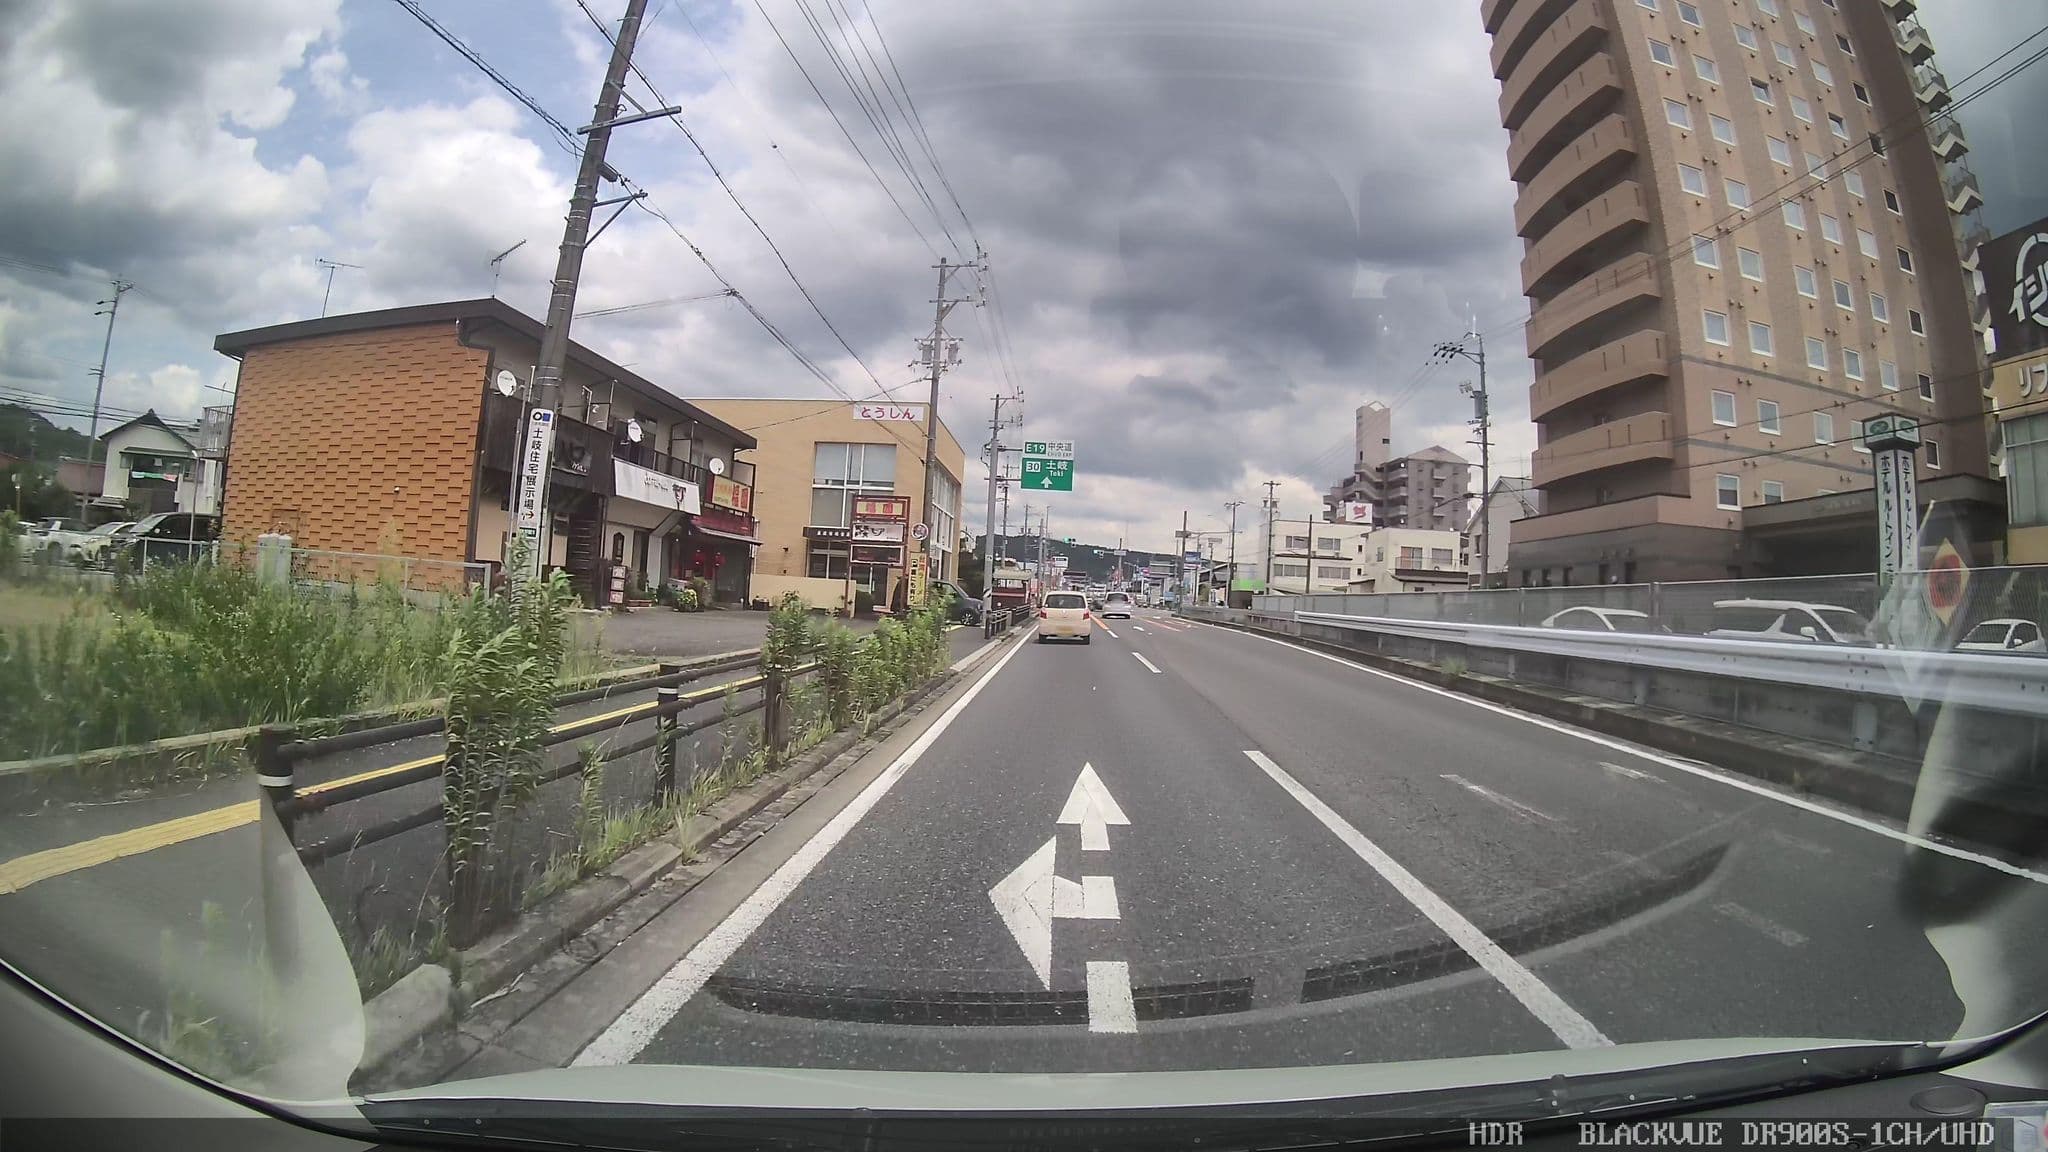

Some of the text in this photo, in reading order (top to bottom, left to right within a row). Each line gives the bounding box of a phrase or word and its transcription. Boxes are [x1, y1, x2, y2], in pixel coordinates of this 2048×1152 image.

[861, 407, 915, 420] とうしん
[1026, 444, 1046, 453] E19
[1048, 442, 1072, 452] 中央道
[524, 428, 543, 510] 土岐住宅展示場
[1027, 462, 1040, 471] 30
[1046, 460, 1068, 471] 土岐
